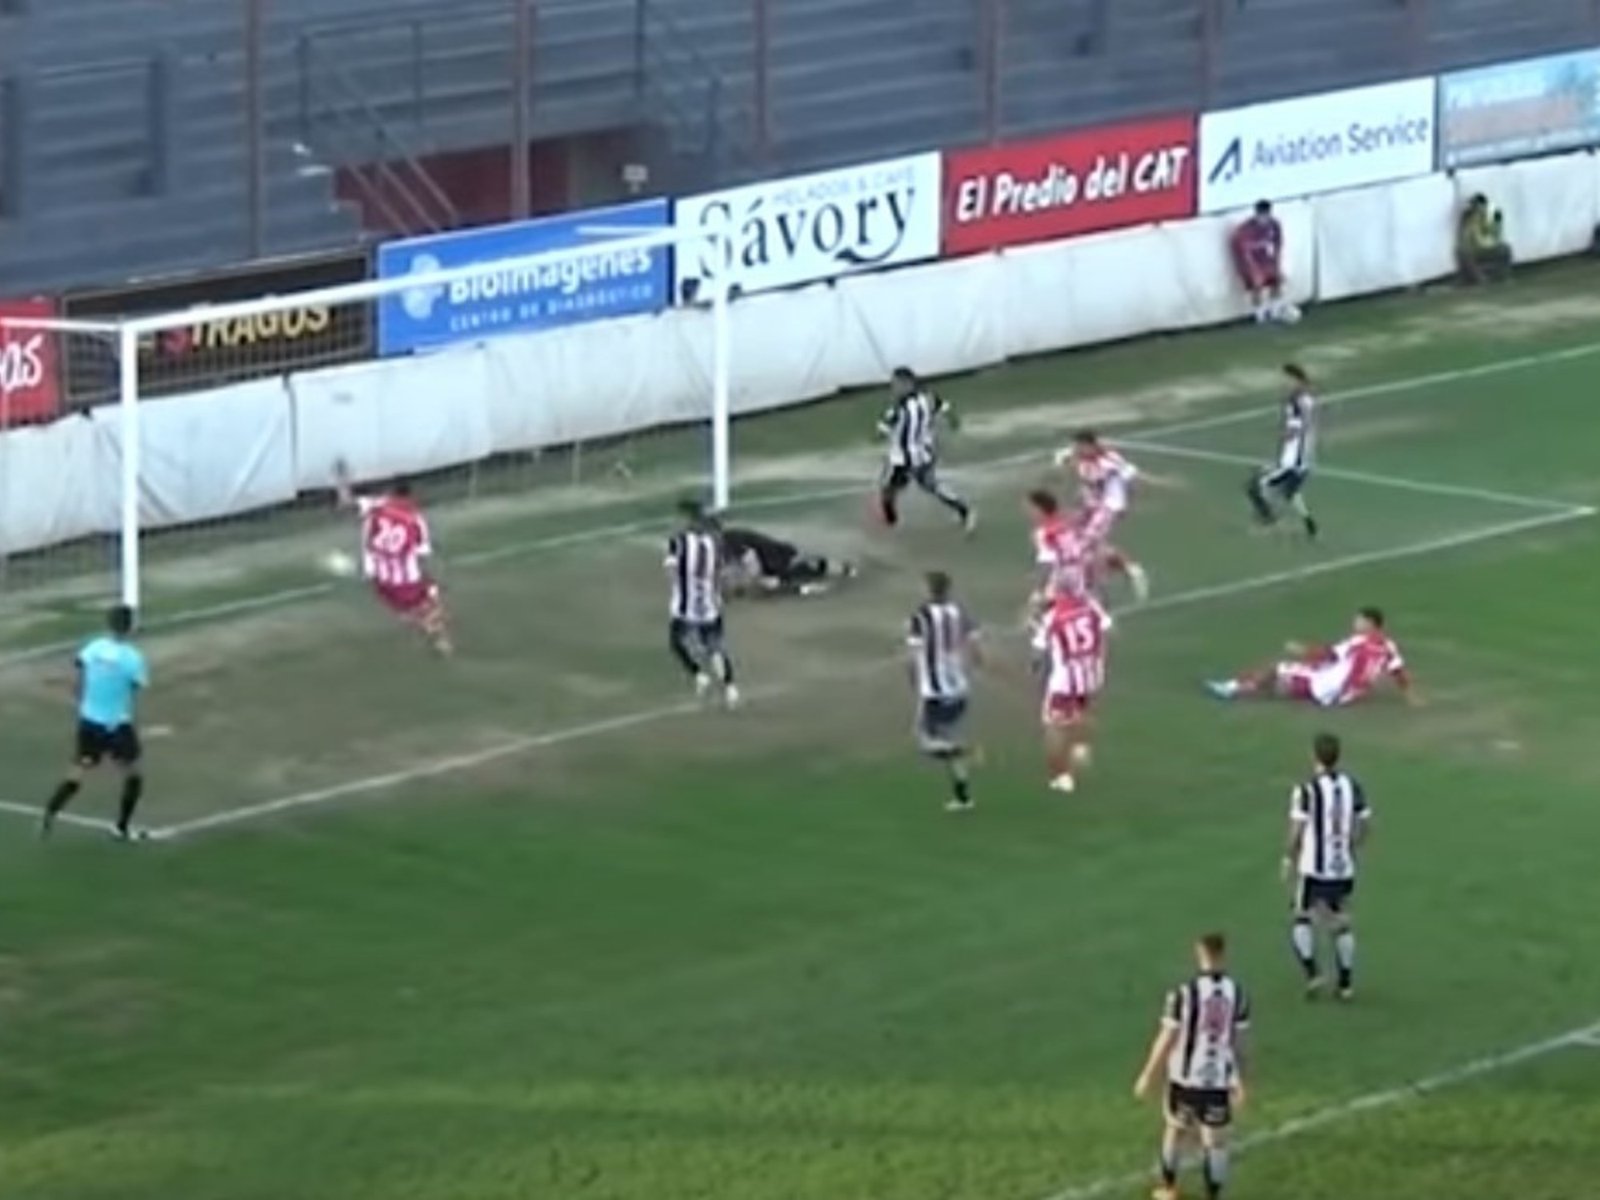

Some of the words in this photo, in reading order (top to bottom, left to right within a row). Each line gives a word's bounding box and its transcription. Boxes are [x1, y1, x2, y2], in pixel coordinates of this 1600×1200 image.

[1250, 127, 1343, 169] Aviation
[1347, 113, 1429, 154] Service
[956, 175, 988, 222] El
[992, 163, 1079, 215] Predio
[1084, 152, 1128, 201] del
[1132, 146, 1190, 191] CAT
[373, 516, 408, 553] 20
[1064, 616, 1095, 653] 15
